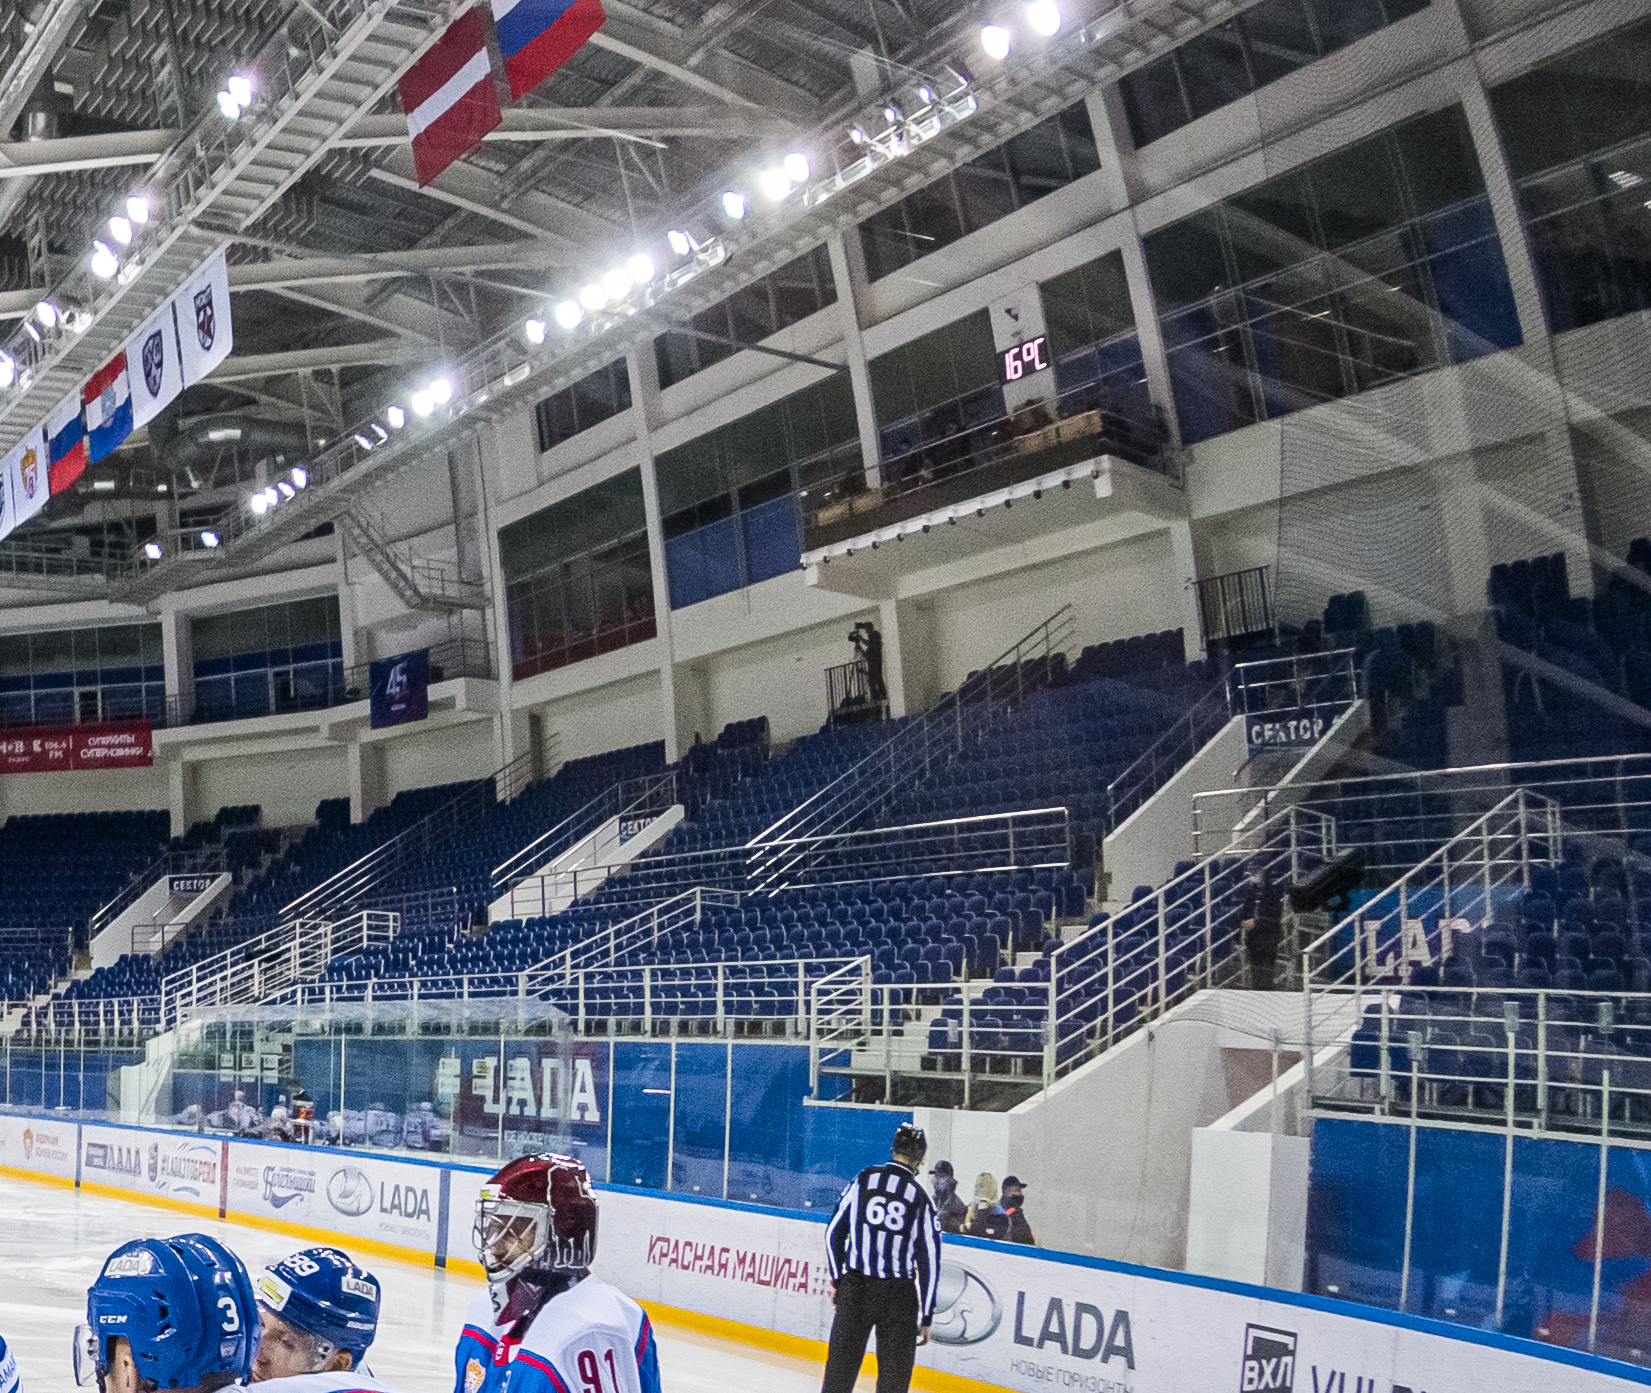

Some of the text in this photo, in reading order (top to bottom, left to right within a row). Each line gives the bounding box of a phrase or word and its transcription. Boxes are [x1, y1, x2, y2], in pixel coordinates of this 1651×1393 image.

[483, 1056, 601, 1122] LADA
[379, 1181, 431, 1223] LADA
[866, 1195, 907, 1231] 68
[107, 1255, 142, 1275] LADA
[284, 1253, 321, 1278] 89
[648, 1235, 810, 1294] КРАСНАЯ МАШИНА
[346, 1281, 375, 1297] LADA
[99, 1314, 128, 1325] CCM
[216, 1296, 241, 1333] 3
[1014, 1290, 1136, 1370] LADA
[1010, 1357, 1054, 1382] НОВЫЕ
[1244, 1354, 1293, 1392] ВХЛ
